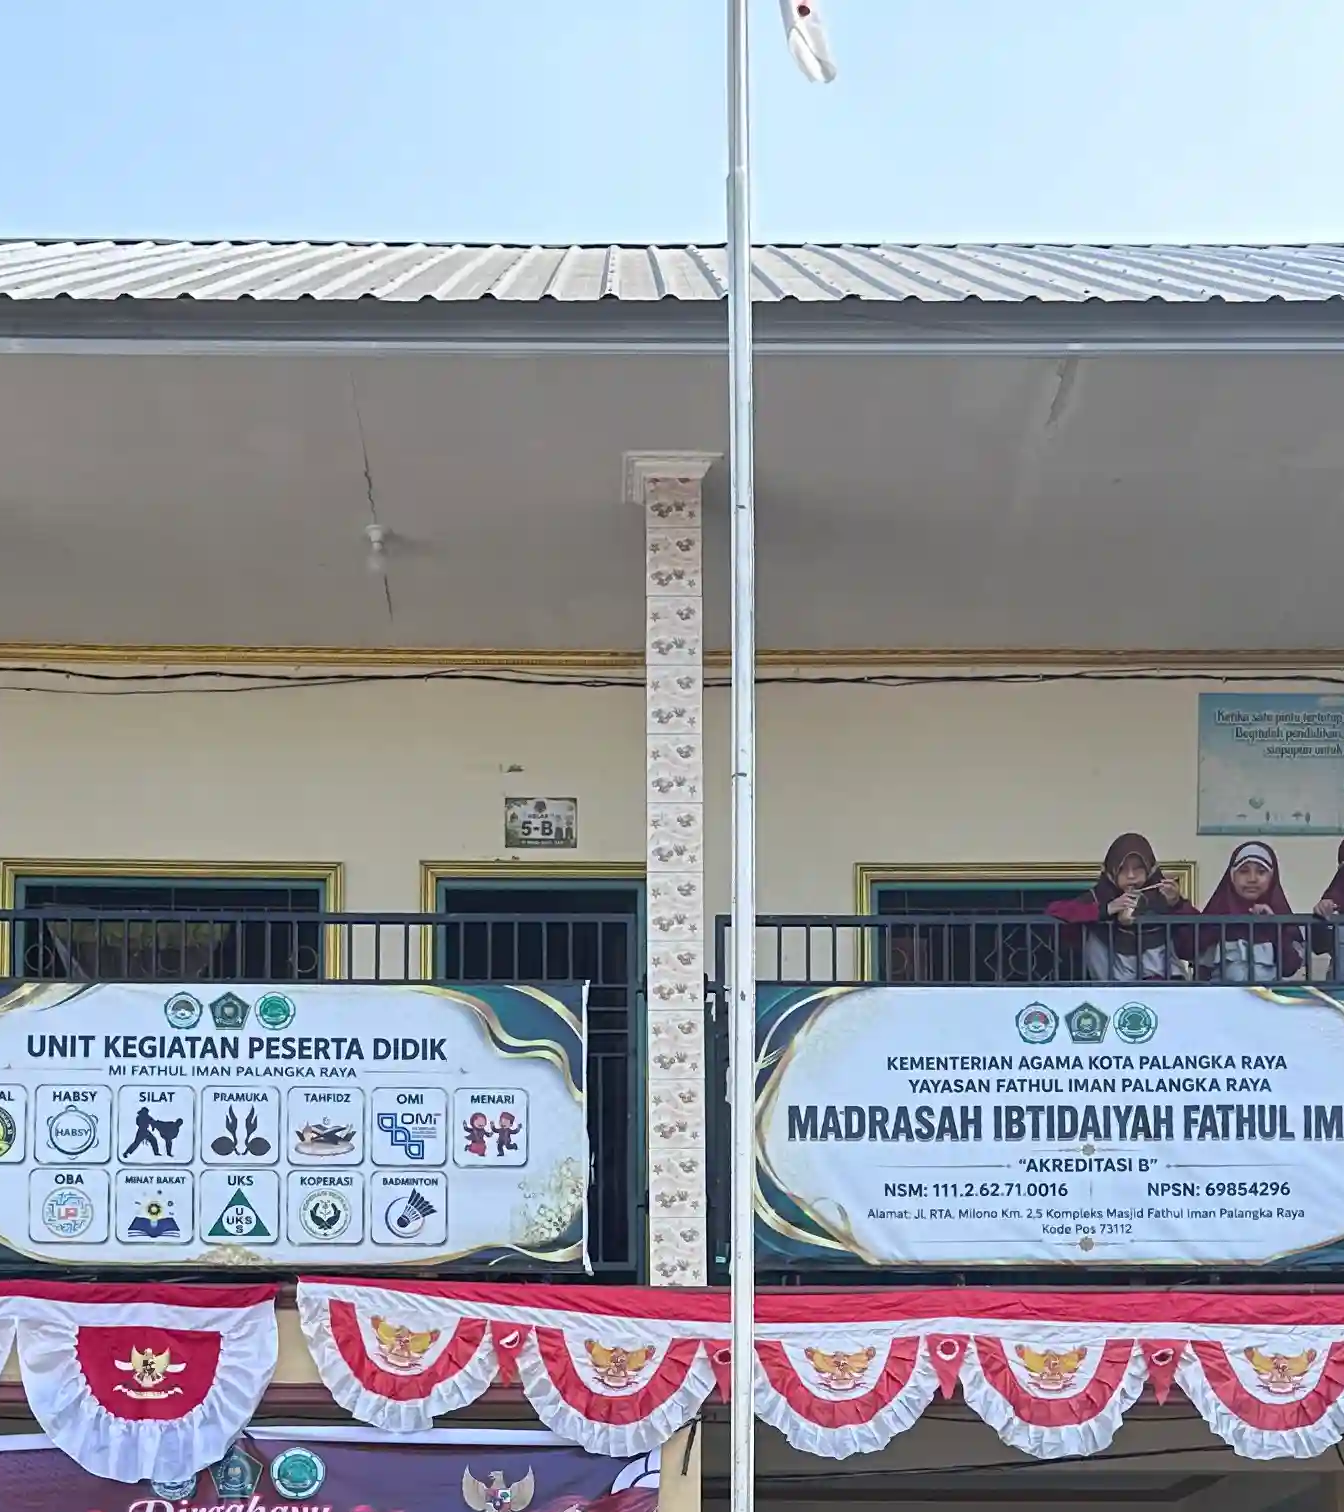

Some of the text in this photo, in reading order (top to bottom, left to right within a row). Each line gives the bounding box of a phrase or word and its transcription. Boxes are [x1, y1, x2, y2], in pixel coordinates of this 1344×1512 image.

[521, 821, 553, 836] 5-B
[27, 1034, 448, 1061] UNIT KEGIATAN PESERTA DIDIK
[887, 1054, 1288, 1071] KEMENTERIAN AGAMA KOTA PALANGKA RAYA
[108, 1064, 357, 1078] MI FATHUL IMAN PALANGKA RAYA
[908, 1077, 1272, 1094] YAYASAN FATHUL IMAN PALANGKA RAYA
[52, 1090, 98, 1103] HABSY
[138, 1091, 176, 1103] SILAT
[213, 1092, 269, 1104] PRAMUKA
[303, 1092, 351, 1103] TAHFIDZ
[396, 1093, 424, 1105] OMI
[470, 1094, 515, 1105] MENARI
[787, 1104, 983, 1143] MADRASAH
[993, 1104, 1174, 1142] IBTIDAIYAH
[1183, 1103, 1296, 1142] FATHUL
[56, 1128, 92, 1137] HABSY
[54, 1173, 84, 1185] OBA
[124, 1175, 186, 1185] MINAT BAKAT
[227, 1175, 254, 1186] UKS
[299, 1175, 353, 1187] KOPERASI
[382, 1177, 439, 1187] BADMINTON
[884, 1182, 1069, 1198] NSM: 111.2.62.71.0016
[1147, 1181, 1291, 1197] NPSN: 69854296
[867, 1208, 911, 1220] Alamat:
[929, 1208, 955, 1220] RTA.
[958, 1208, 998, 1219] Milono
[1001, 1208, 1023, 1219] Km.
[1046, 1208, 1104, 1221] Kompleks
[1106, 1207, 1144, 1221] Masjid
[1147, 1207, 1184, 1219] Fathul
[1186, 1208, 1217, 1219] Iman
[1219, 1207, 1273, 1221] Palangka
[1276, 1207, 1305, 1221] Raya
[226, 1216, 253, 1225] UKS
[1041, 1223, 1133, 1235] Kode Pos 73112
